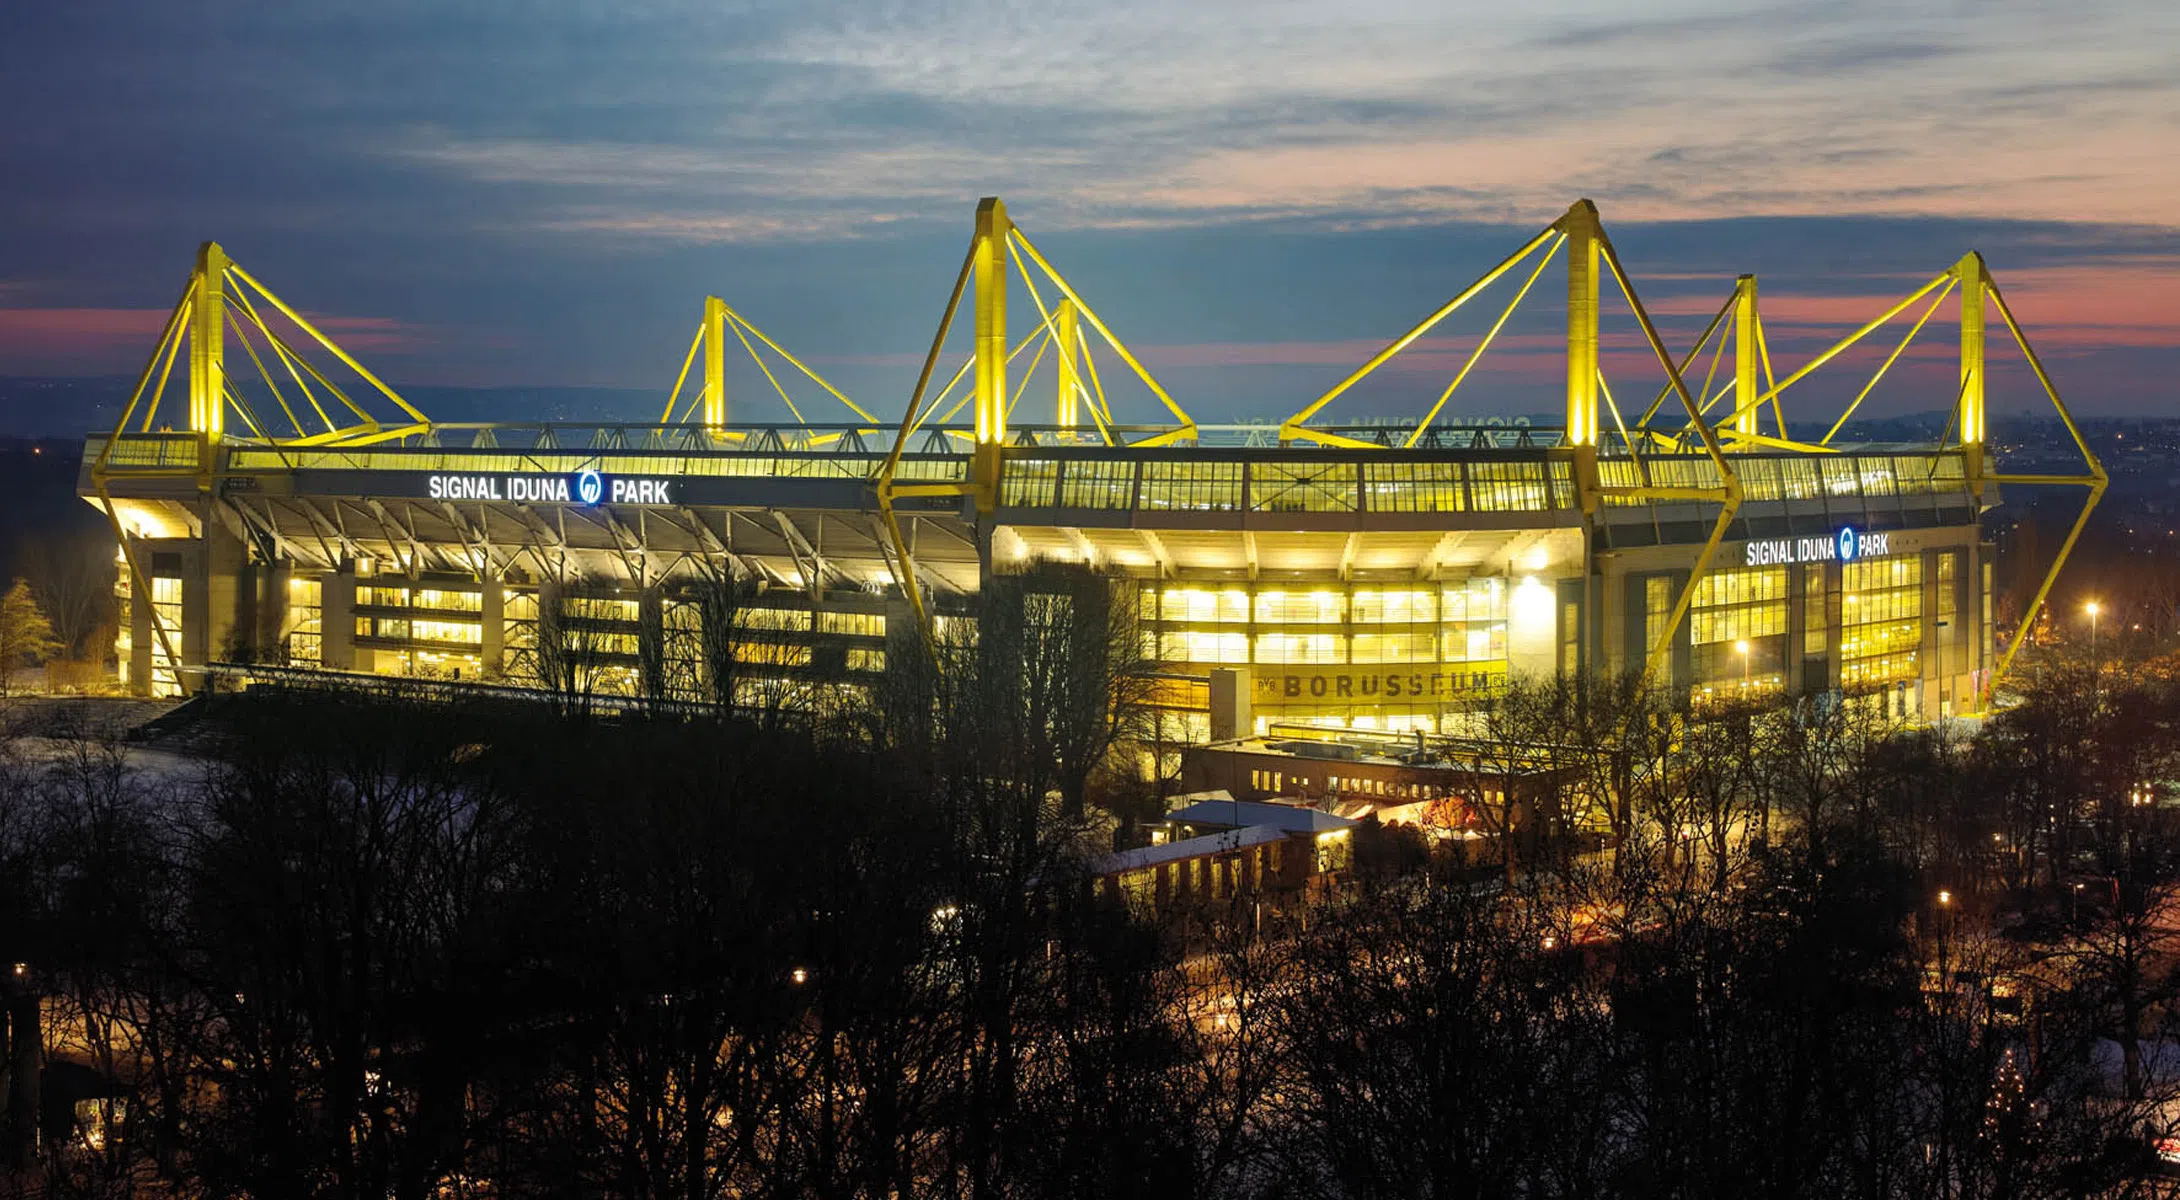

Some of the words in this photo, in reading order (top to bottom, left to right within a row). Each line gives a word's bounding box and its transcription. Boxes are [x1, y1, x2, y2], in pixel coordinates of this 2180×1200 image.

[429, 476, 501, 499] SIGNAL
[507, 477, 570, 501] IDUNA
[612, 480, 670, 503] PARK
[1746, 538, 1795, 566] SIGNAL
[1797, 537, 1836, 562] IDUNA
[1858, 533, 1889, 557] PARK
[1284, 671, 1488, 697] BORUSSEUM
